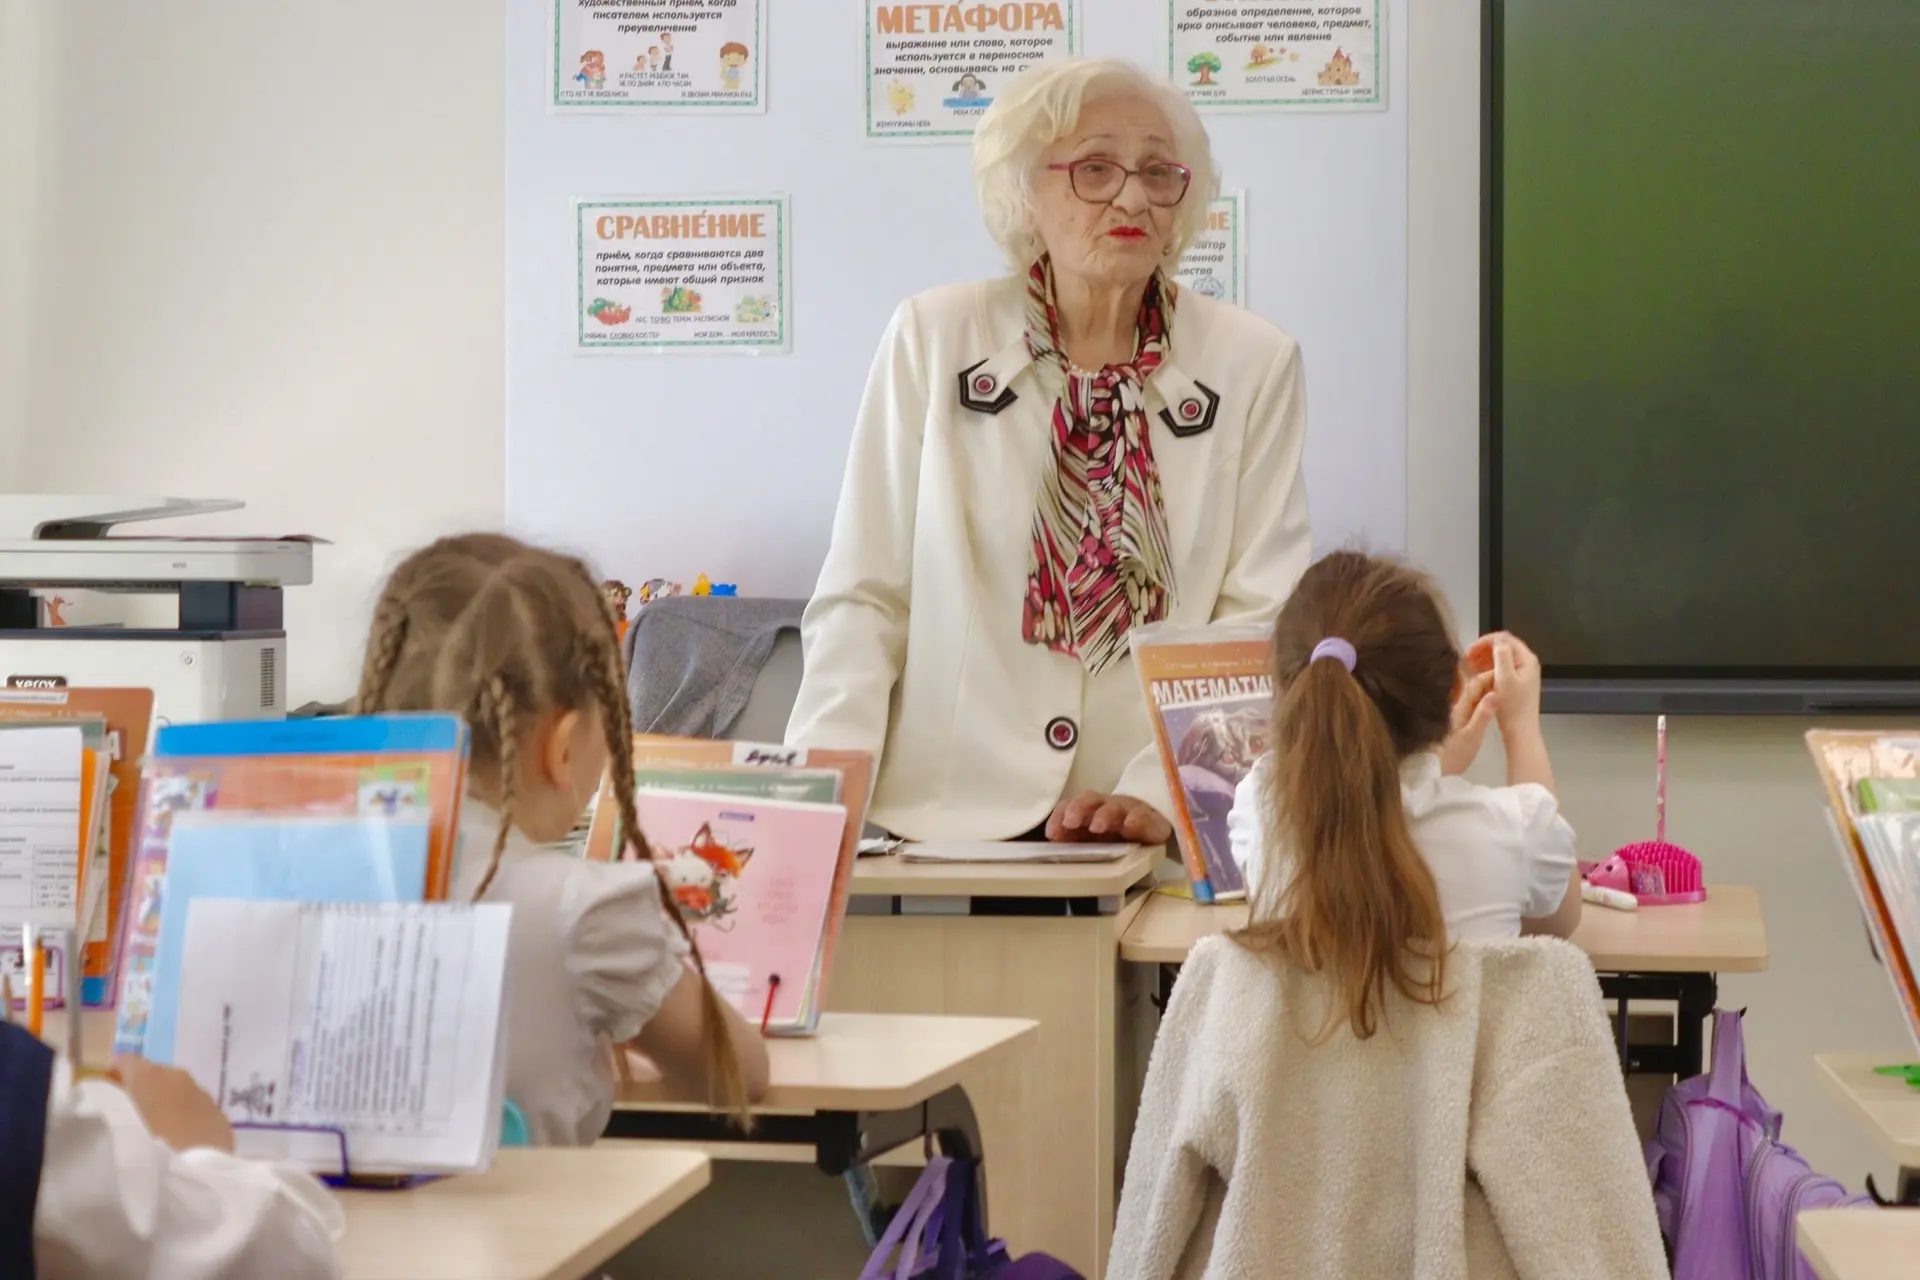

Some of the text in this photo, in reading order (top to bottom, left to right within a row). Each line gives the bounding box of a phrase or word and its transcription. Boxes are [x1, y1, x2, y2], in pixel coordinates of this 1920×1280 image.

[708, 0, 737, 8] когда
[592, 11, 722, 21] писателем используется
[1186, 6, 1362, 18] образное определение, которое
[617, 24, 697, 34] преувеличение
[1176, 20, 1372, 31] ярко описывает человека, предмет,
[885, 37, 1053, 50] выражение или слово, которое
[1215, 33, 1332, 43] событие или явление
[895, 51, 1044, 63] используется в переносном
[873, 66, 926, 76] значении,
[928, 65, 999, 74] основываясь
[1001, 65, 1015, 73] на
[596, 250, 764, 261] приём, когда сравниваются два
[595, 262, 766, 273] понятия, предмета или объекта,
[596, 274, 764, 286] которые имеют общий признак
[15, 679, 57, 688] xerox
